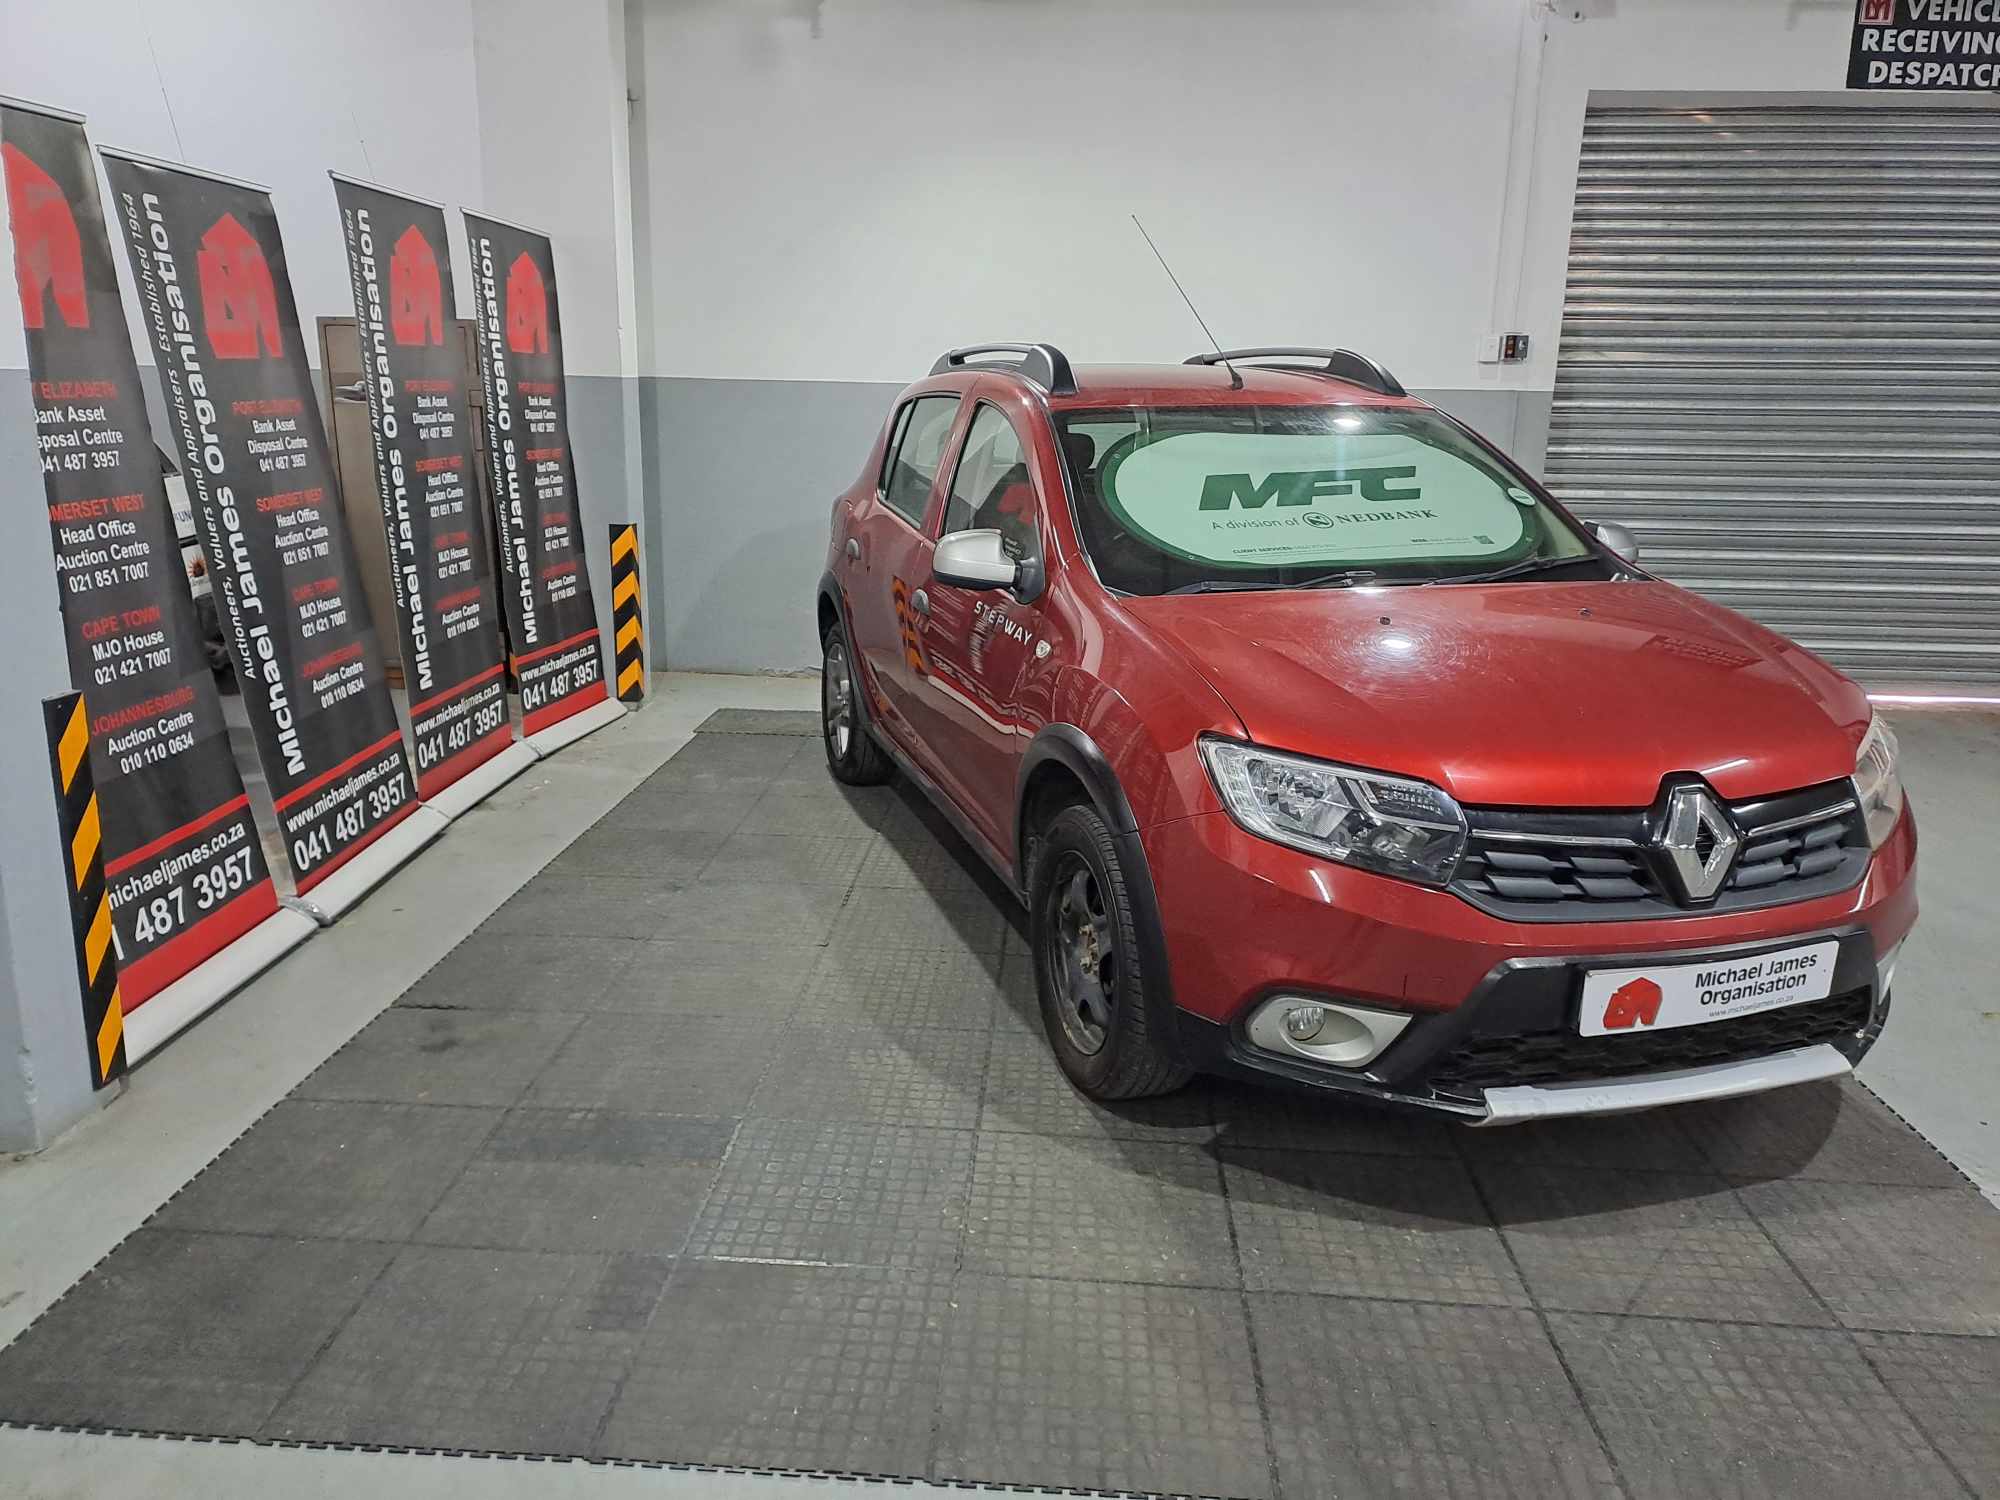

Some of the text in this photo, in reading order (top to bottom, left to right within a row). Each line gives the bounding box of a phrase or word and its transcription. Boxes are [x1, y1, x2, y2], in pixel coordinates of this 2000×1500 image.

[1861, 29, 2000, 54] RECEIVIN
[121, 192, 143, 239] 1964
[134, 245, 171, 352] Established
[67, 405, 107, 422] Asset
[168, 368, 200, 463] Appraisers
[252, 418, 296, 433] Bank Asset
[82, 428, 124, 445] Centre
[247, 437, 284, 455] Disposal
[373, 431, 384, 460] and
[64, 453, 86, 471] 487
[91, 450, 120, 469] 3957
[111, 494, 144, 512] WEST
[190, 467, 208, 502] and
[378, 463, 392, 517] Valuers
[389, 448, 414, 556] James
[503, 439, 523, 530] James
[1199, 465, 1422, 511] MFC
[60, 520, 136, 545] Head Office
[203, 506, 226, 570] Valuers
[276, 508, 319, 528] Head Office
[1211, 509, 1439, 530] A division of NEDBANK
[56, 541, 150, 571] Auction Centre
[216, 486, 263, 615] James
[275, 532, 304, 548] Auction
[69, 562, 150, 593] 021 851 7007
[513, 537, 537, 644] Michael
[82, 605, 160, 640] CAPE TOWN
[316, 597, 341, 614] House
[974, 600, 1033, 645] STEPWAY
[92, 630, 164, 661] MJO House
[402, 564, 433, 690] Michael
[95, 648, 172, 685] 021 421 7007
[313, 662, 363, 693] Auction Centre
[523, 659, 597, 710] 041 487 3957
[92, 686, 194, 736] JOHANNESBURG
[250, 624, 306, 776] Michael
[415, 683, 500, 736] www.michaeljames.co.za
[108, 711, 194, 756] Auction Centre
[120, 731, 194, 774] 010 110 0634
[418, 700, 502, 769] 041 487 3957
[286, 752, 400, 833] www.michaeljames.co.za
[293, 772, 406, 871] 041 487 3957
[134, 886, 185, 943] 487
[192, 846, 252, 909] 3957
[1695, 953, 1818, 989] Michael James
[1699, 972, 1808, 1006] Organisation
